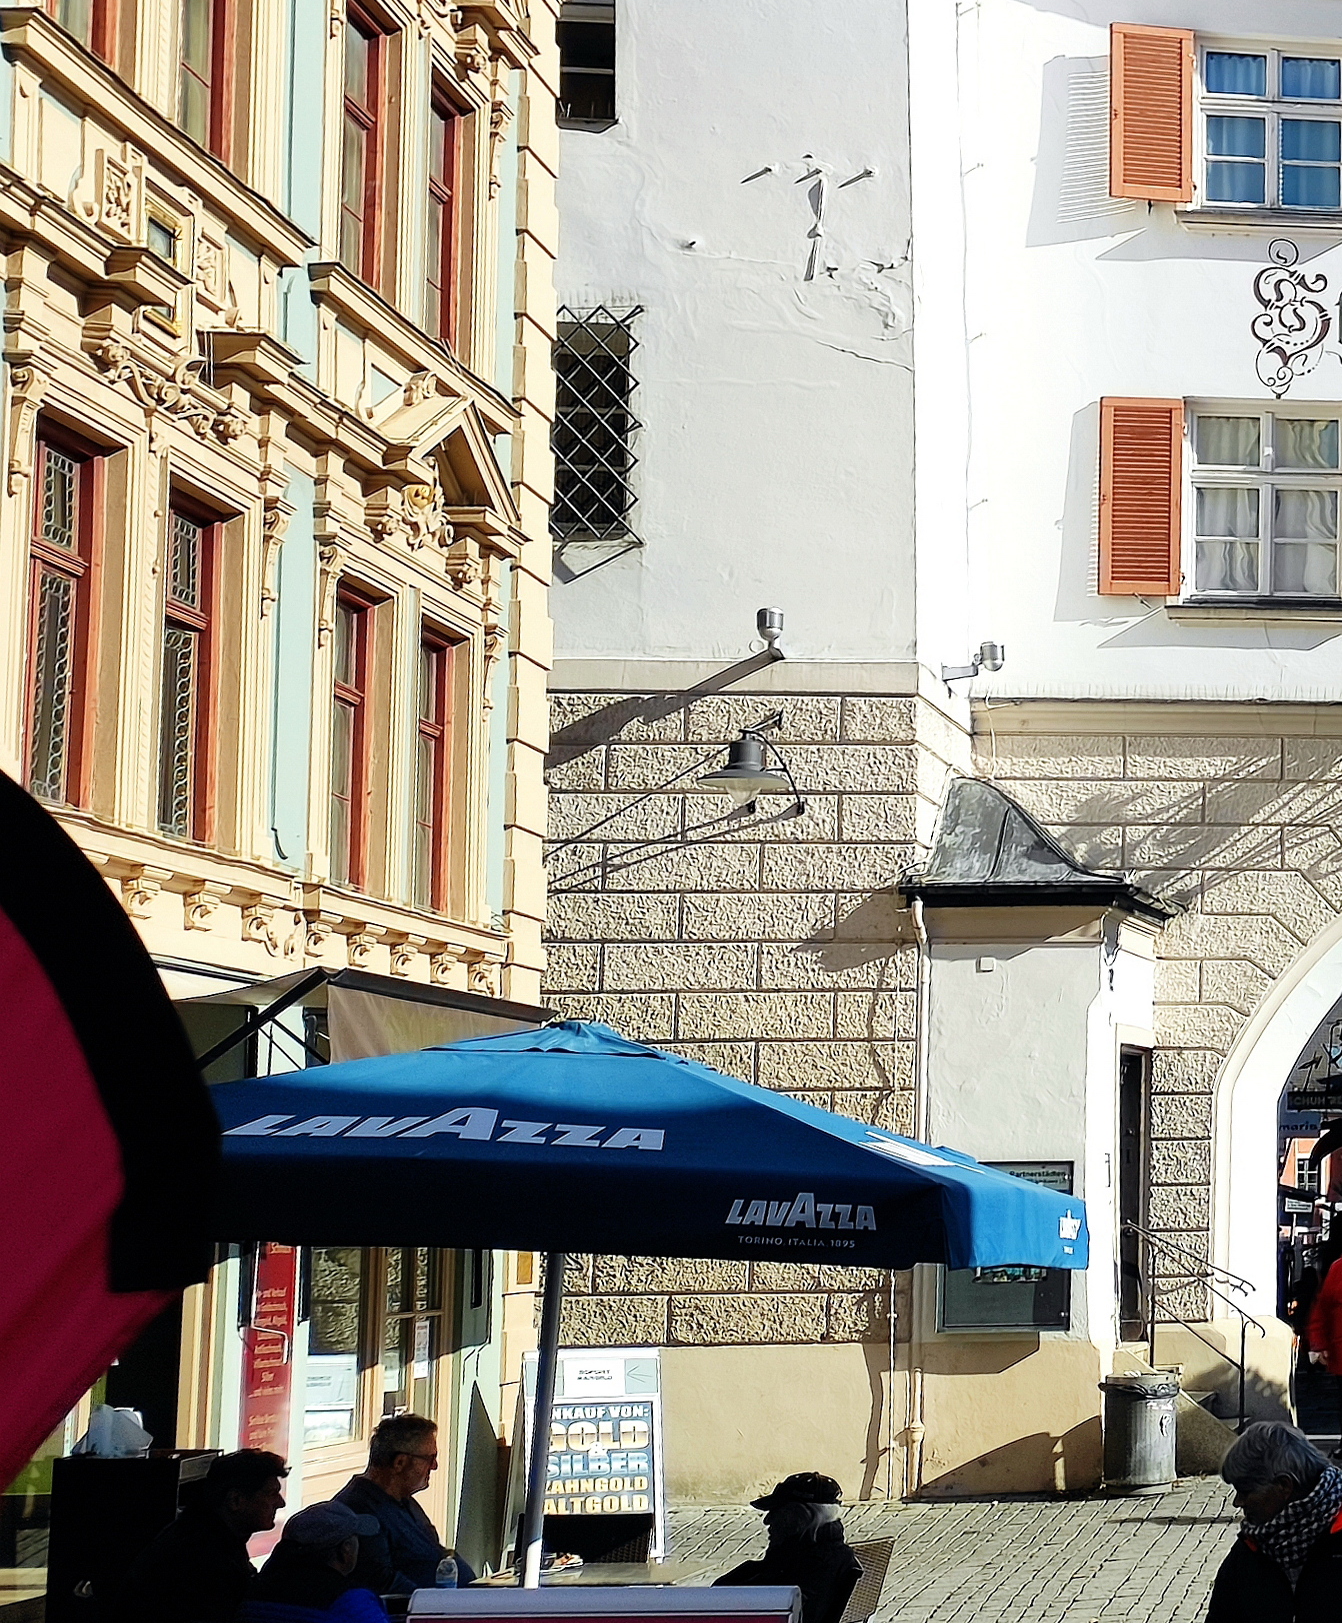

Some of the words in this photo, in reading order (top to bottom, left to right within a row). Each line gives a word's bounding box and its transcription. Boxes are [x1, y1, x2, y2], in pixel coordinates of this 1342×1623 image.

[223, 1106, 666, 1151] LAVAZZA
[724, 1192, 877, 1231] LAVAZZA
[830, 1239, 856, 1249] 1895
[551, 1406, 606, 1420] NKAUF
[608, 1405, 650, 1418] VON:
[546, 1453, 649, 1477] SILBER
[543, 1494, 650, 1515] ALTGOLD
